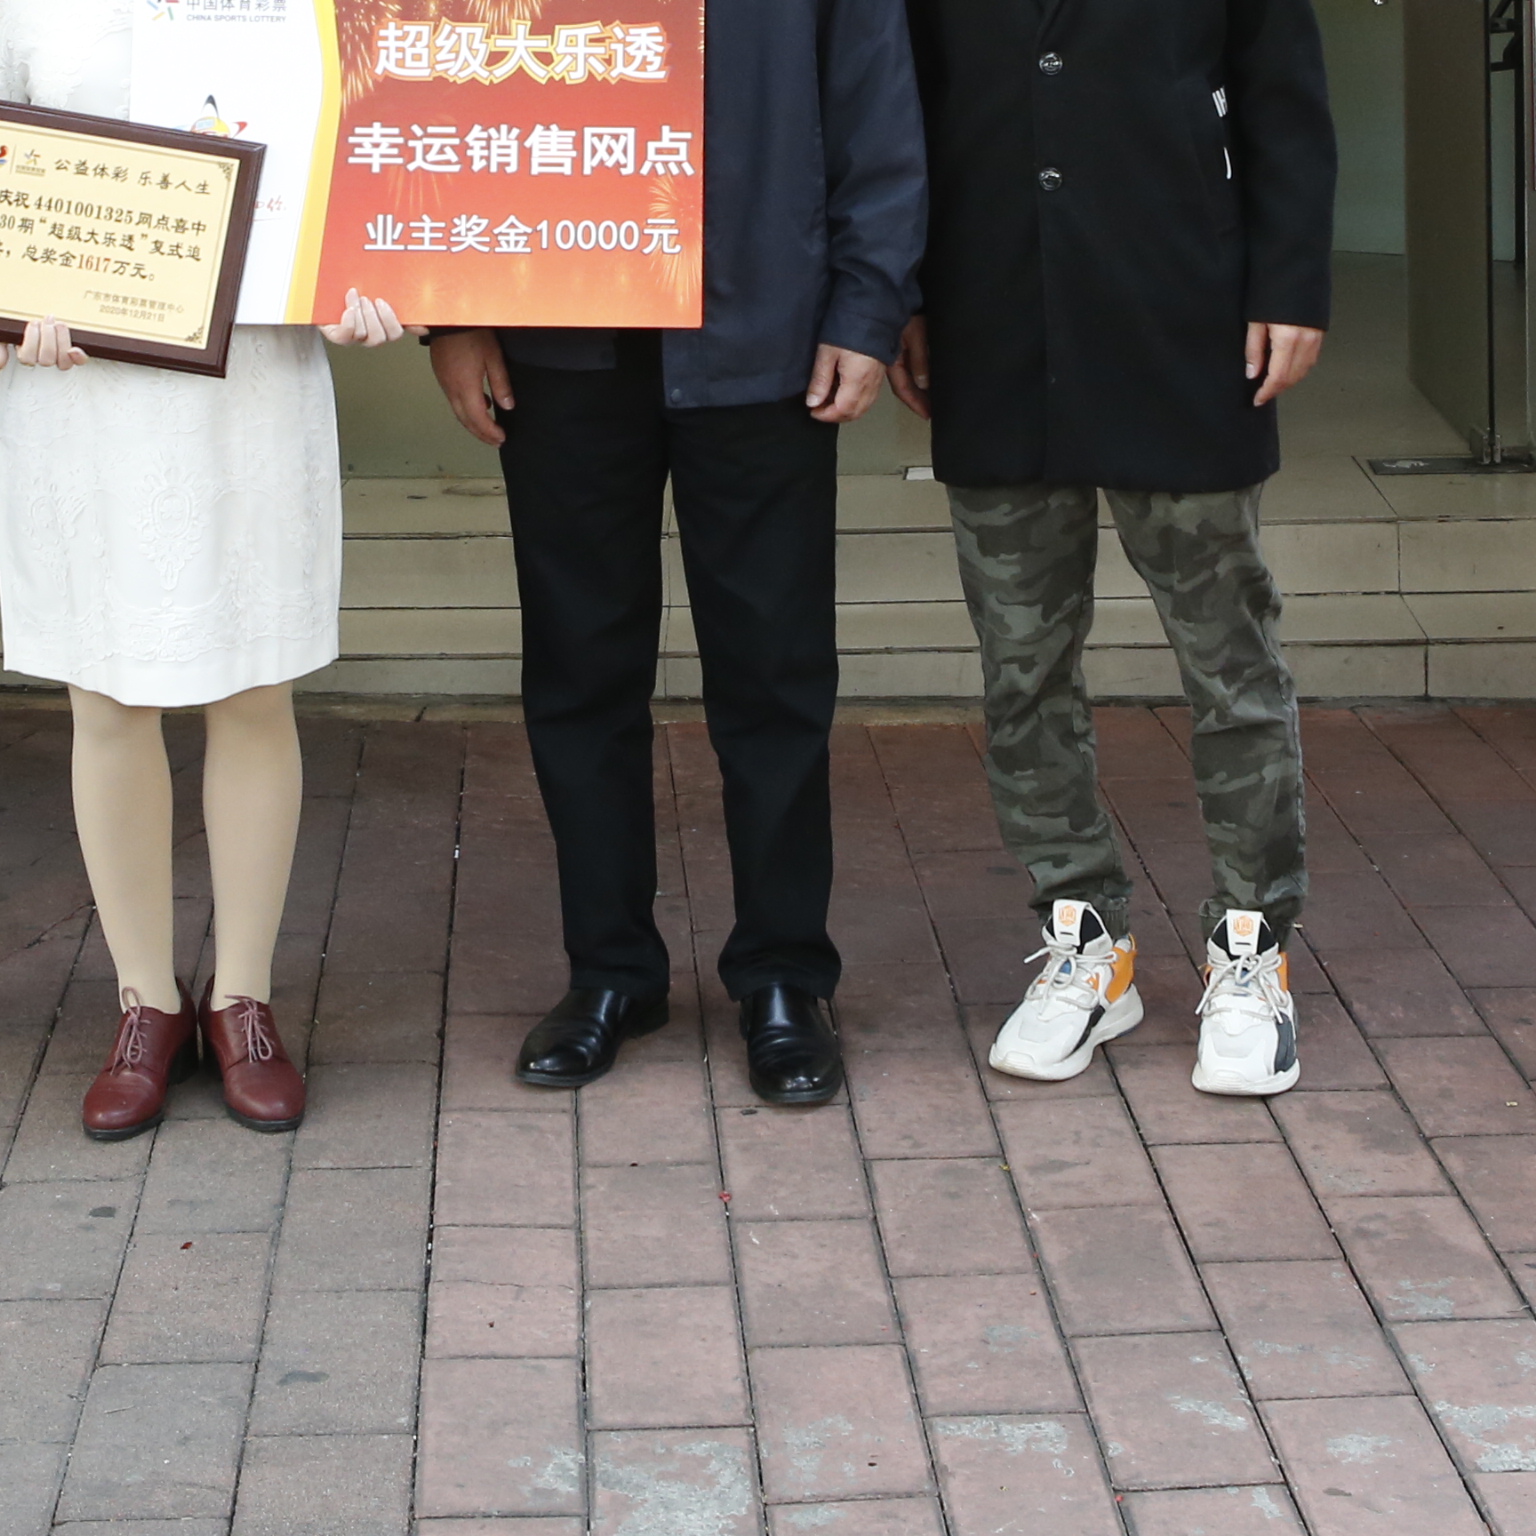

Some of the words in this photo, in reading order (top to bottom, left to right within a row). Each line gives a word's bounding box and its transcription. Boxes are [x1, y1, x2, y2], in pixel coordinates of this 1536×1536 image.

[186, 14, 212, 22] CHINA
[214, 14, 247, 23] SPORTS
[249, 15, 287, 23] LOTTERY
[374, 21, 667, 82] 超级大乐透
[348, 123, 695, 178] 幸运销售网点
[54, 157, 129, 183] 公益体彩
[137, 170, 211, 196] 乐善人生
[364, 213, 681, 257] 业主奖金10000元
